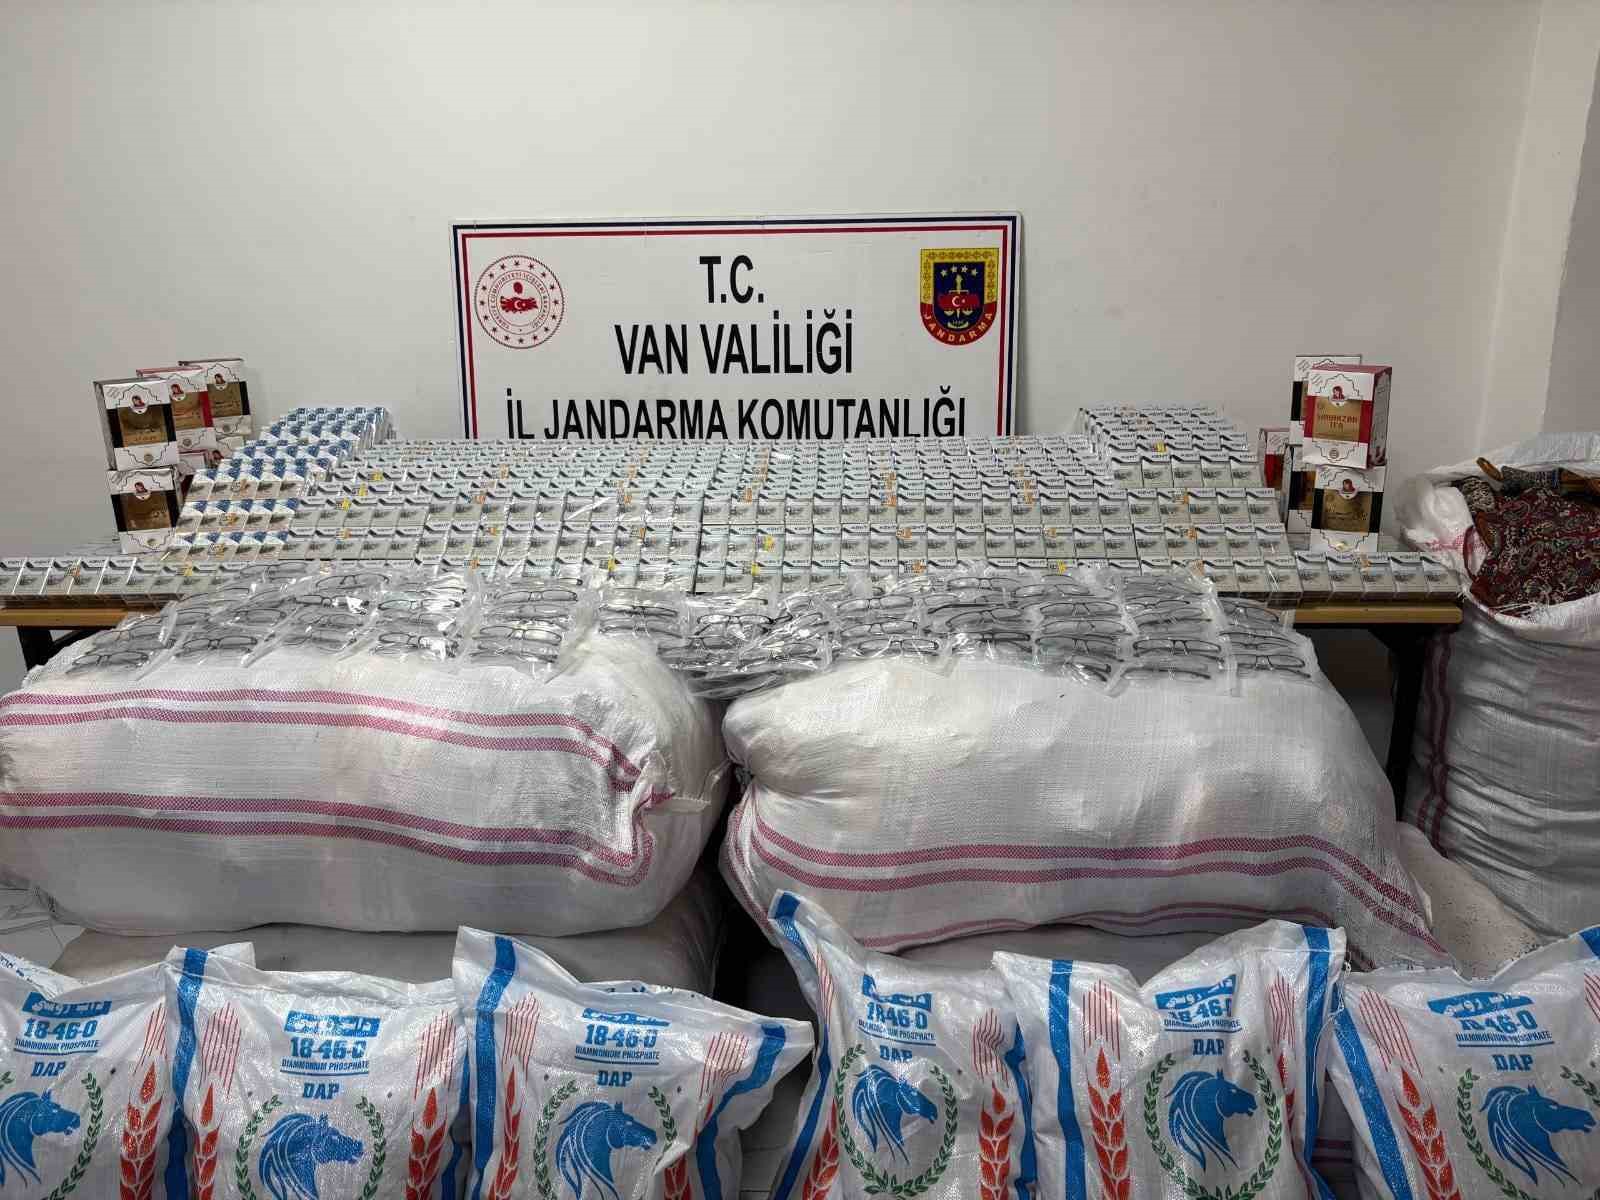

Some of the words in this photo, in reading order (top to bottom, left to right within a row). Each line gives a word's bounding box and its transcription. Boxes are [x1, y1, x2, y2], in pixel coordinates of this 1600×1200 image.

[699, 255, 764, 303] T.C.
[923, 312, 993, 343] JANDARMA
[614, 324, 688, 374] VAN
[699, 308, 853, 374] VALİLİĞİ
[506, 388, 534, 440] İL
[544, 399, 728, 440] JANDARMA
[738, 385, 966, 440] KOMUTANLIĞI
[23, 1017, 98, 1040] 18-46-0
[584, 1023, 657, 1048] 18-46-0
[290, 1036, 367, 1059] 18-46-0
[879, 1044, 913, 1063] DAP
[1192, 1038, 1225, 1056] DAP
[31, 1061, 66, 1077] DAP
[1491, 1054, 1534, 1072] DAP
[597, 1070, 633, 1087] DAP
[303, 1082, 340, 1100] DAP
